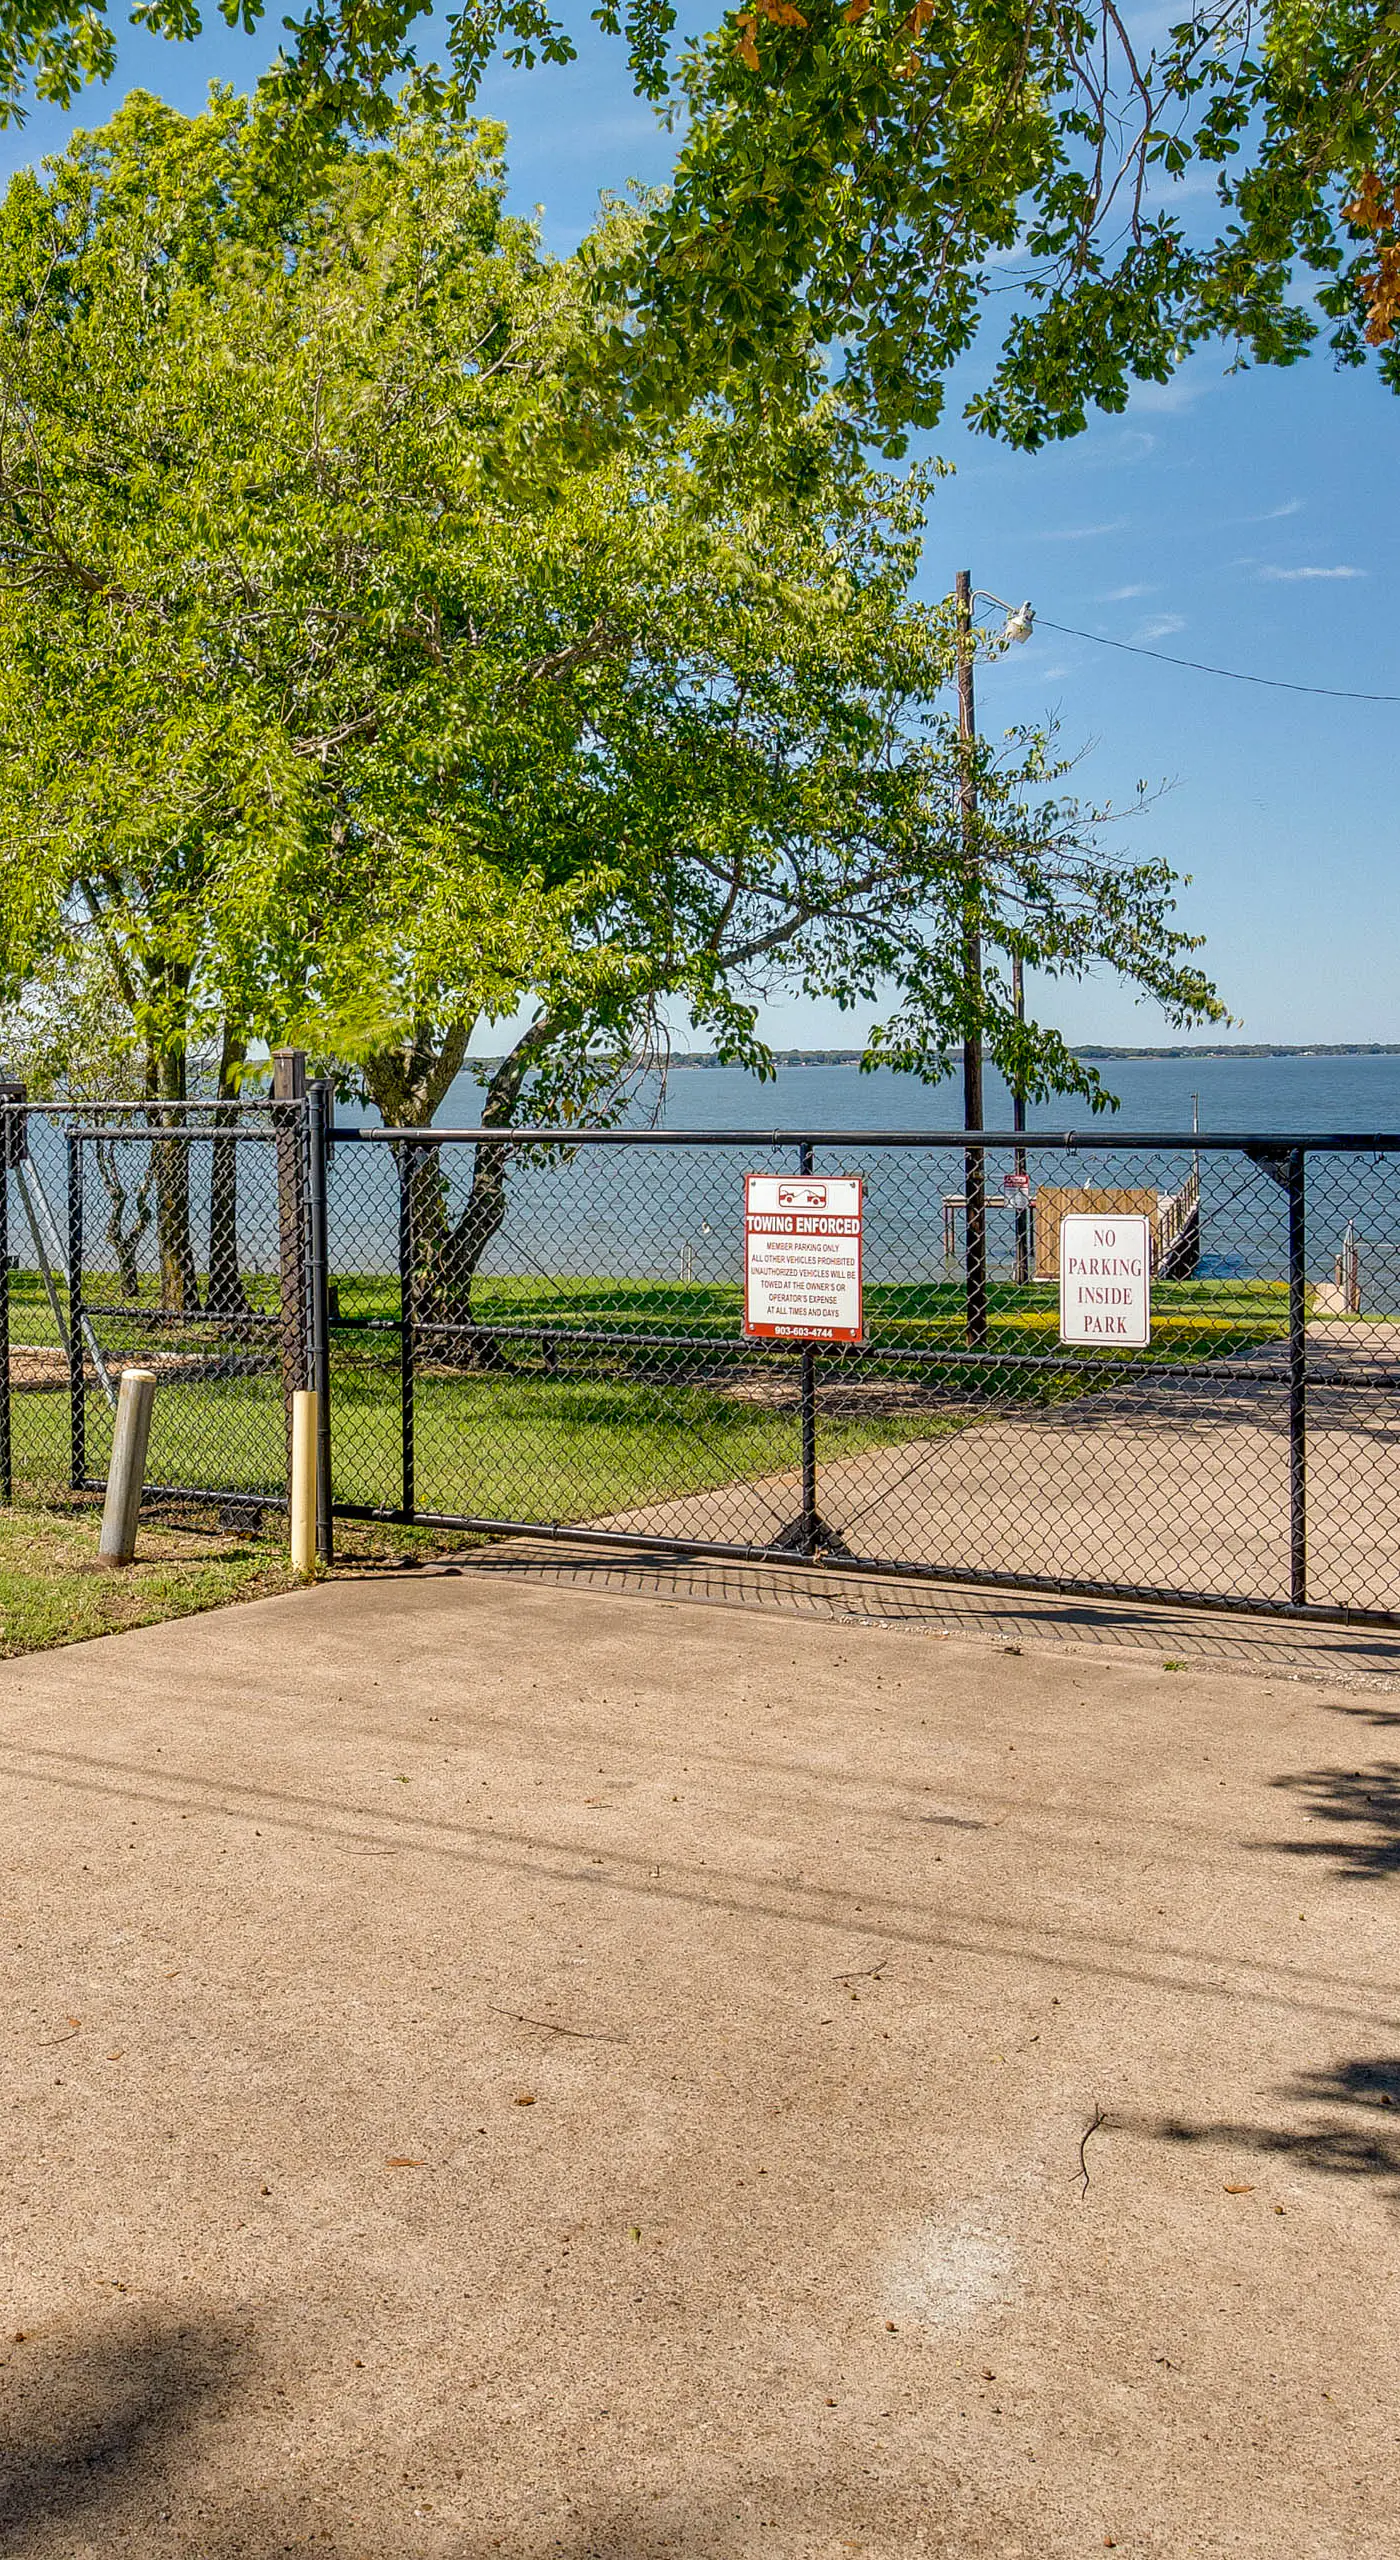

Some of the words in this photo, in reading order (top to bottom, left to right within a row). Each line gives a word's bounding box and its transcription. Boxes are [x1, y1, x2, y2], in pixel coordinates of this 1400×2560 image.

[747, 1216, 793, 1232] TOWING
[796, 1217, 860, 1234] ENFORCED
[1094, 1230, 1116, 1247] NO
[767, 1242, 792, 1250] MEMBER
[795, 1243, 821, 1251] PARKING
[823, 1244, 839, 1252] ONLY
[752, 1254, 763, 1262] ALL
[764, 1255, 784, 1263] OTHER
[787, 1256, 816, 1264] VEHICLES
[818, 1257, 855, 1266] PROHIBITED
[1069, 1258, 1141, 1276] PARKING
[751, 1268, 797, 1276] UNAUTHORIZED
[847, 1271, 856, 1279] BE
[761, 1280, 782, 1288] TOWED
[793, 1282, 804, 1290] THE
[769, 1294, 807, 1302] OPERATOR'S
[809, 1295, 837, 1304] EXPENSE
[1078, 1287, 1132, 1305] INSIDE
[767, 1306, 775, 1314] AT
[789, 1307, 807, 1315] TIMES
[823, 1309, 839, 1317] DAYS
[1084, 1315, 1127, 1333] PARK
[775, 1326, 833, 1337] 903-603-4744
